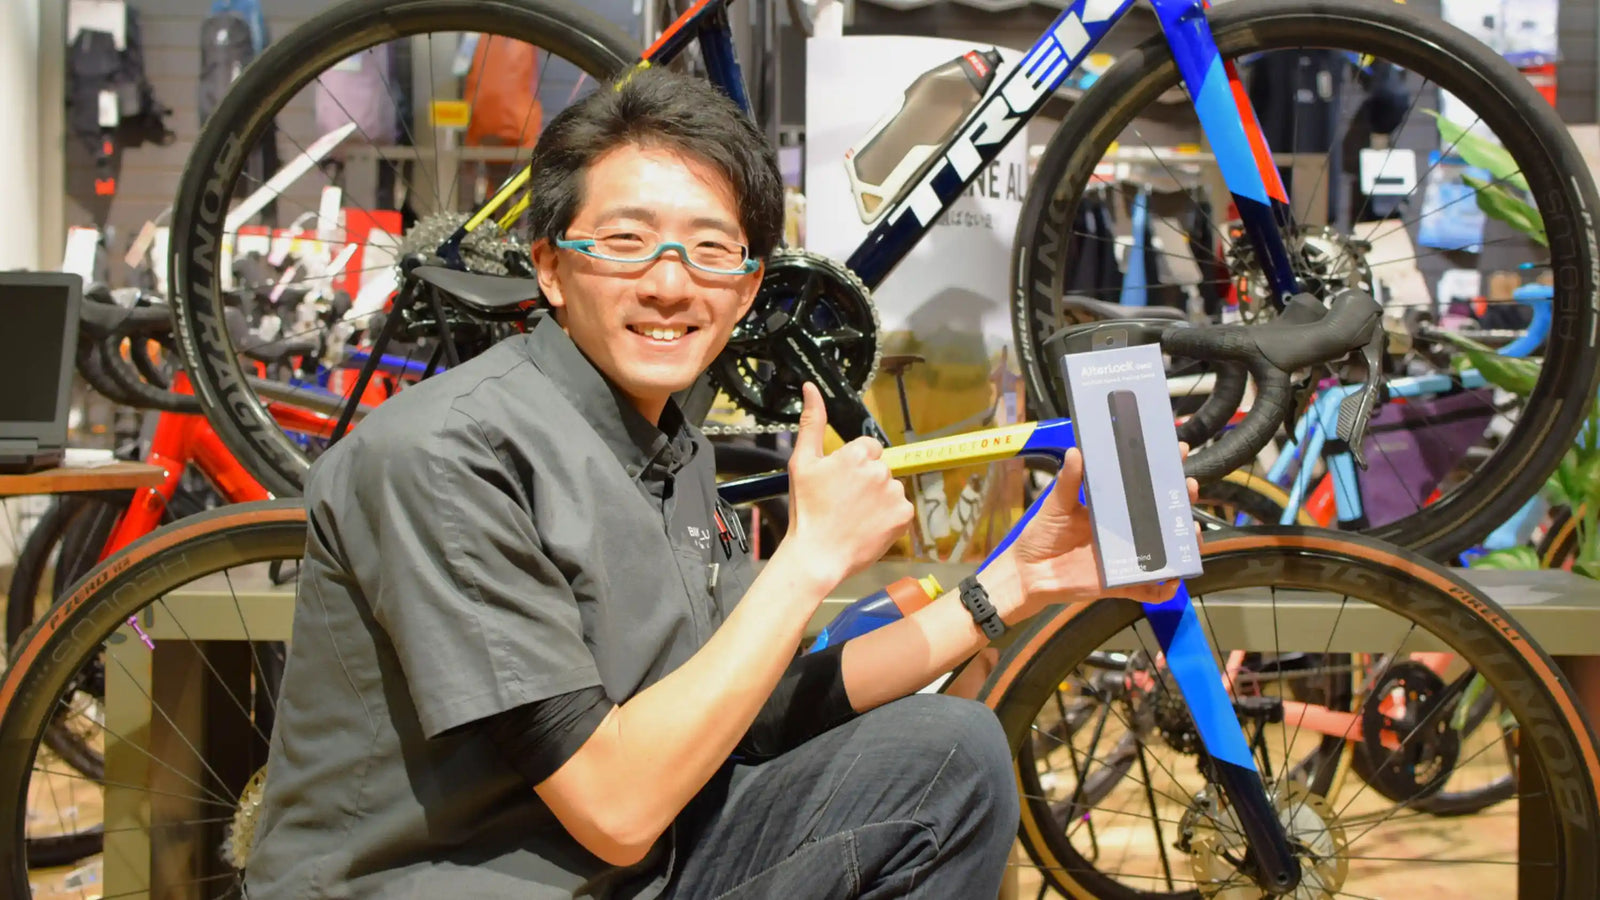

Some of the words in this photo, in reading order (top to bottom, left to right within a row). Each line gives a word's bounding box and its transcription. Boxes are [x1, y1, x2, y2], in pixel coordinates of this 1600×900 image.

[960, 160, 1001, 199] NE
[1016, 288, 1033, 362] PIRELLI
[1448, 586, 1521, 641] PIRELLI
